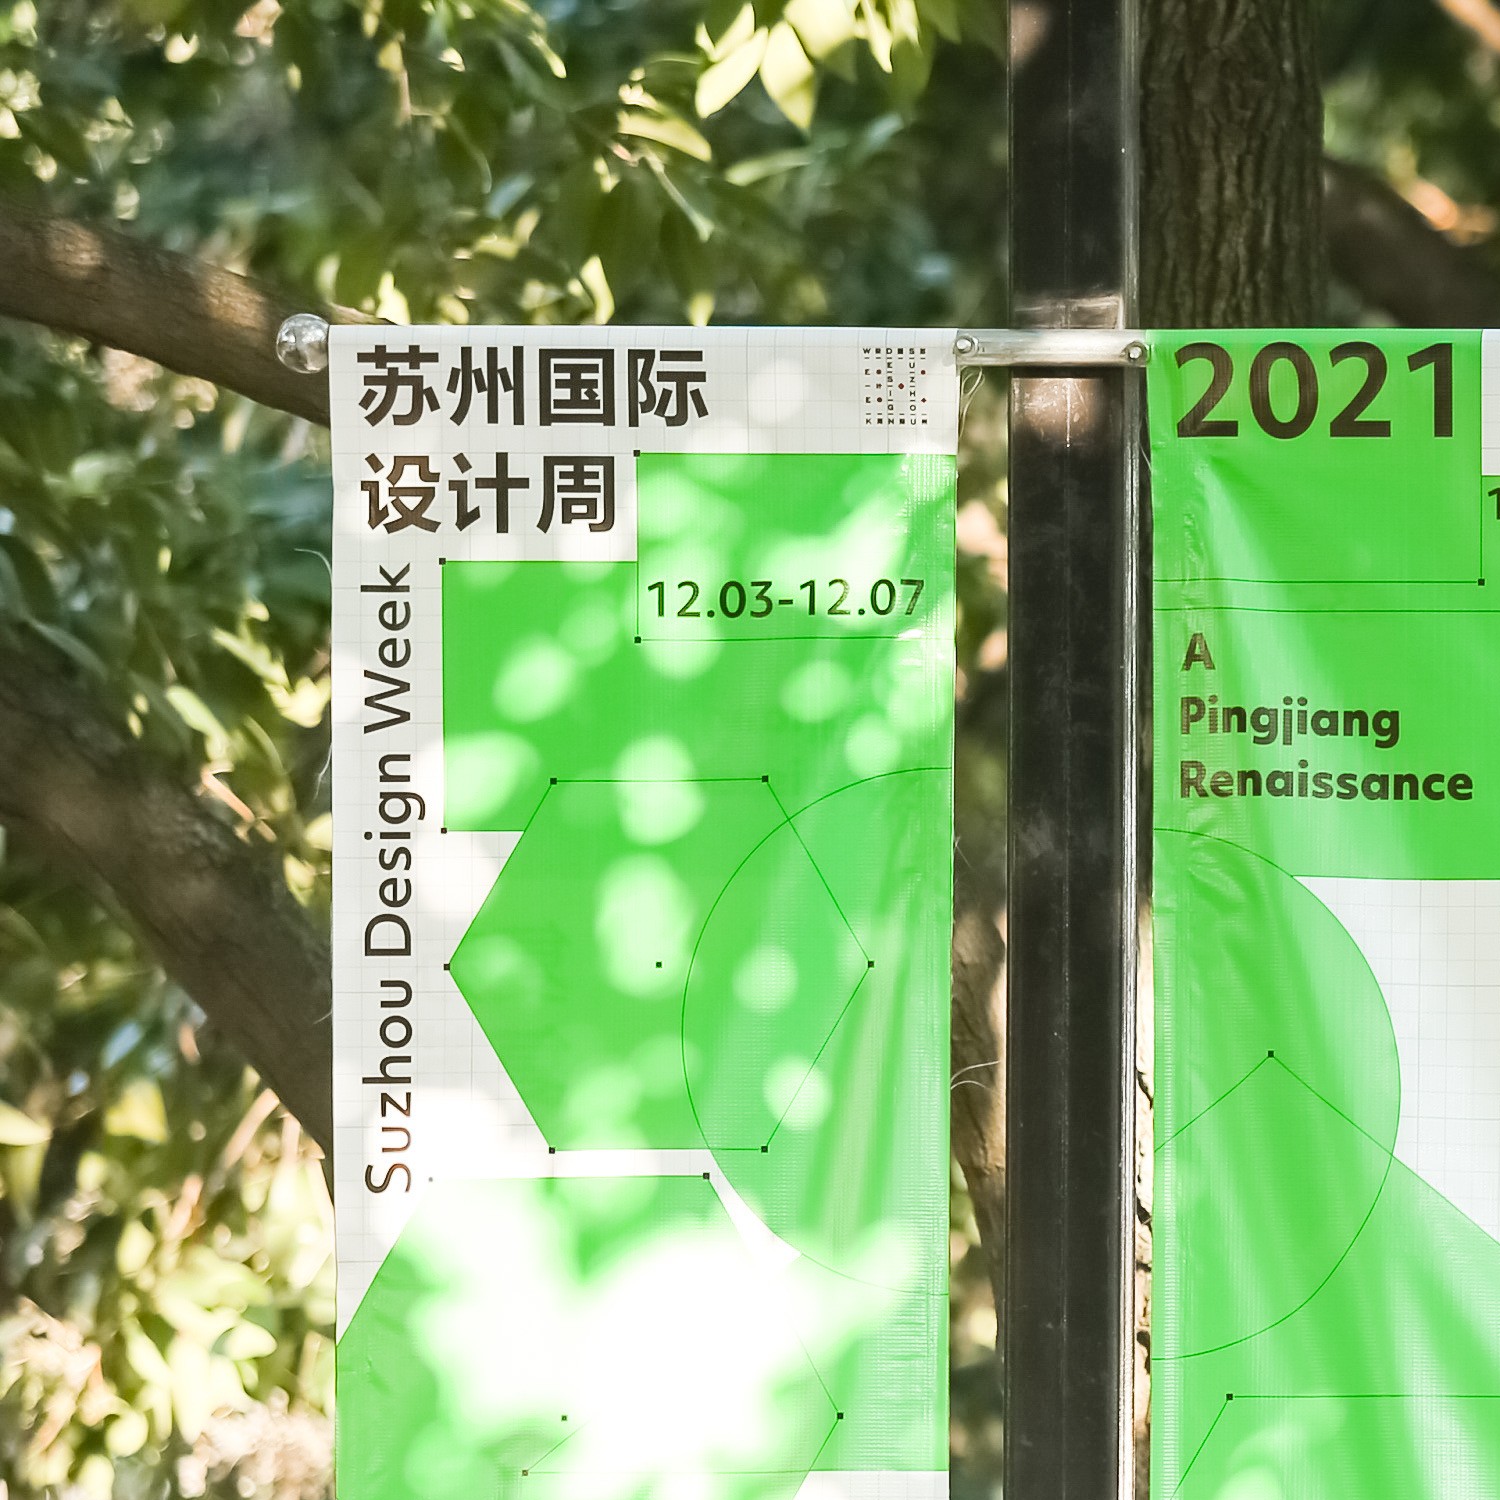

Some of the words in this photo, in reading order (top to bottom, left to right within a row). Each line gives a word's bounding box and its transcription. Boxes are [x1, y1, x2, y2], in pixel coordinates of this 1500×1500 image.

[357, 345, 708, 427] 苏州国际
[1174, 342, 1453, 439] 2021
[361, 452, 615, 534] 设计周
[647, 578, 925, 619] 12.03-12.07
[360, 562, 411, 734] Week
[1182, 632, 1216, 671] A
[1181, 695, 1400, 749] Pingjiang
[1181, 759, 1474, 801] Renaissance
[364, 754, 426, 956] Design
[362, 980, 413, 1193] Suzhou
